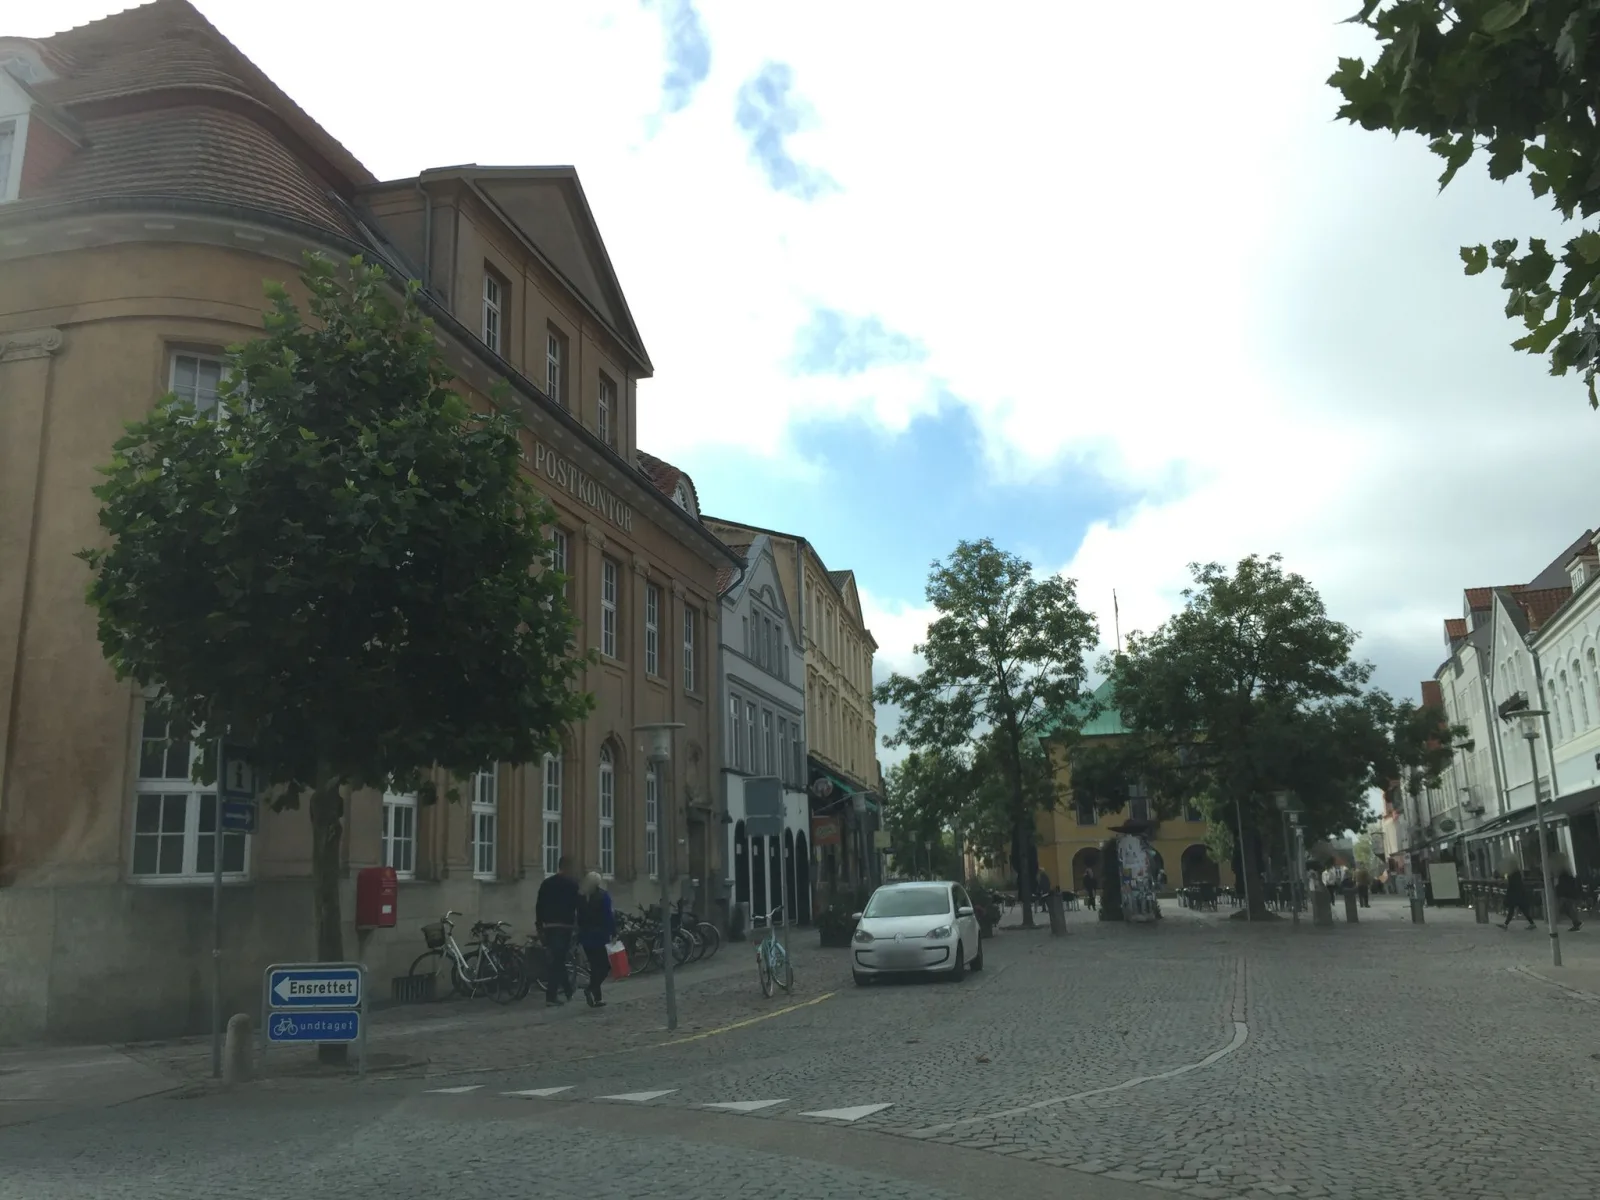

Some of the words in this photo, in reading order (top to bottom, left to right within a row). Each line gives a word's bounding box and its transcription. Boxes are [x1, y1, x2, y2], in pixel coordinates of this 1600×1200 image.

[535, 442, 632, 532] POSTKONTOR
[290, 980, 353, 995] Ensrettet
[300, 1020, 353, 1032] undtaget
